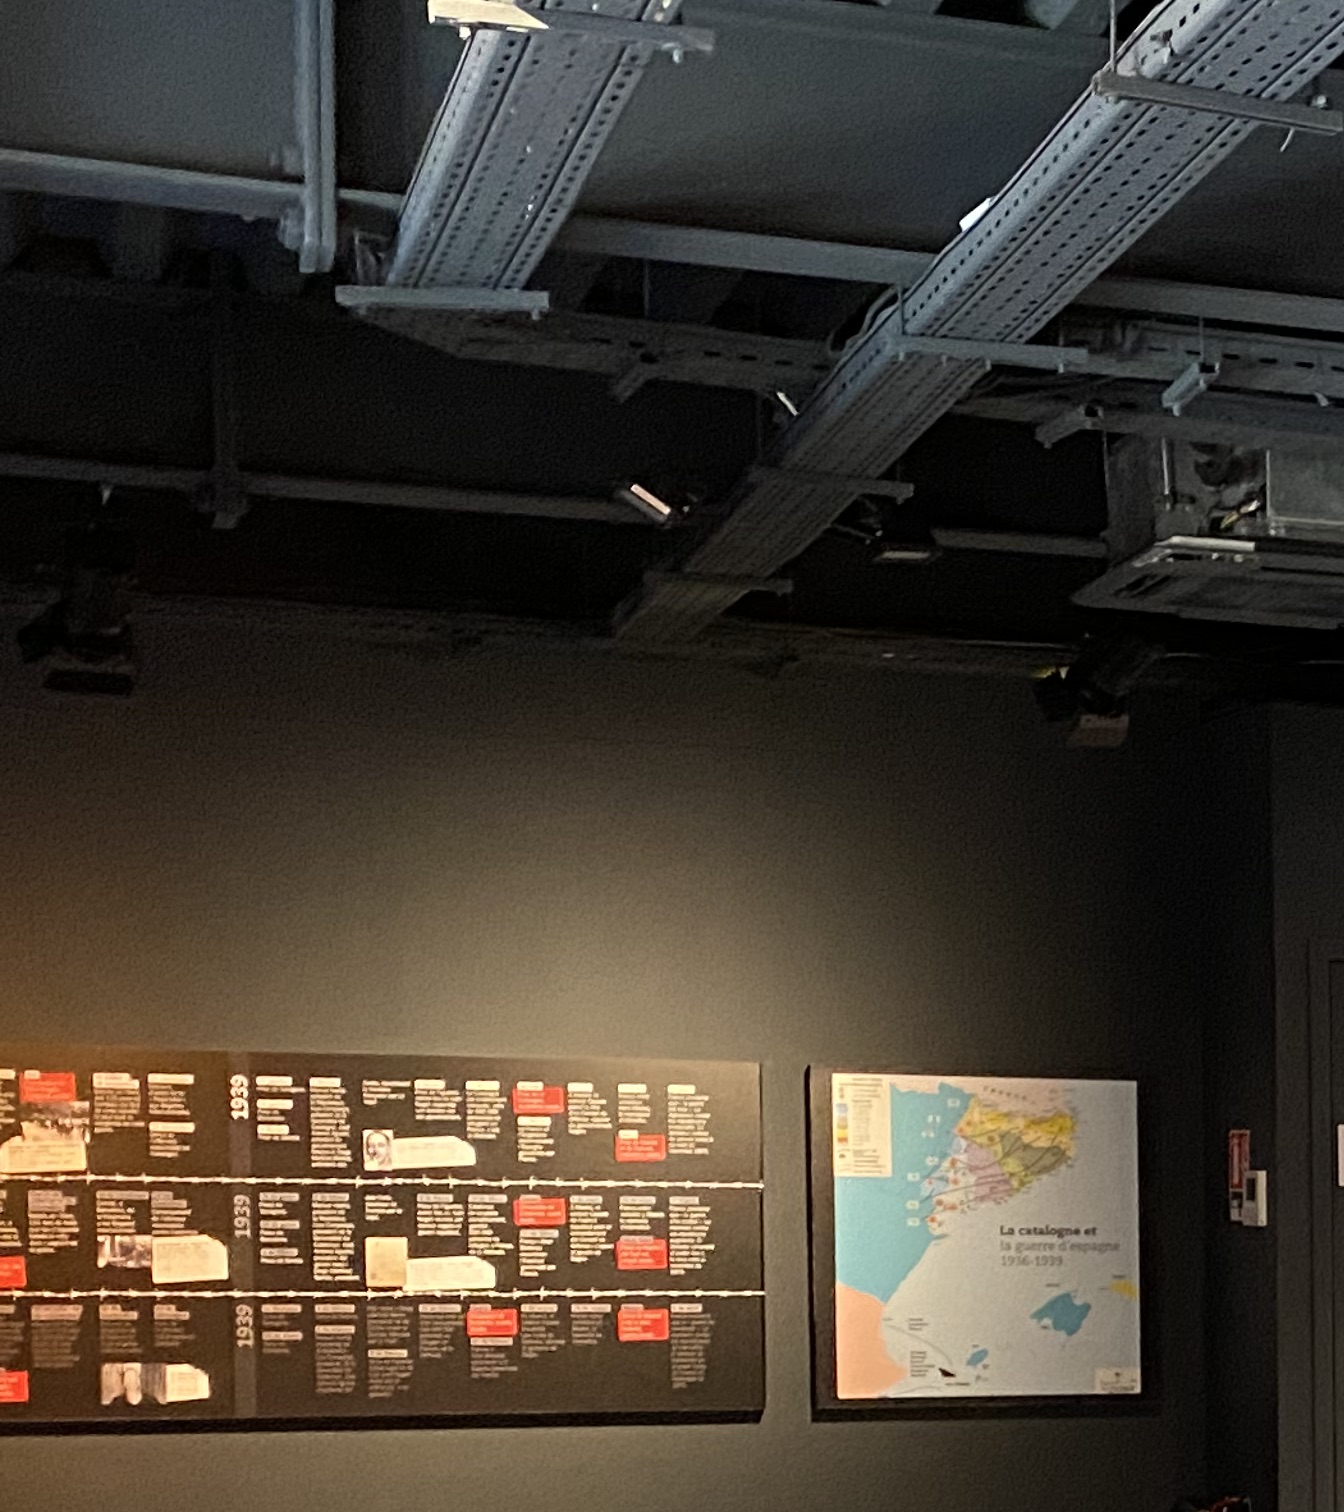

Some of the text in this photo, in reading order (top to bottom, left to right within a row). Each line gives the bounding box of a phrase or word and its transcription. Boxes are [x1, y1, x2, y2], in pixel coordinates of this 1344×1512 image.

[229, 1074, 249, 1120] 1939
[233, 1194, 251, 1239] 1939
[1000, 1225, 1015, 1236] La
[1018, 1224, 1081, 1239] catalogne
